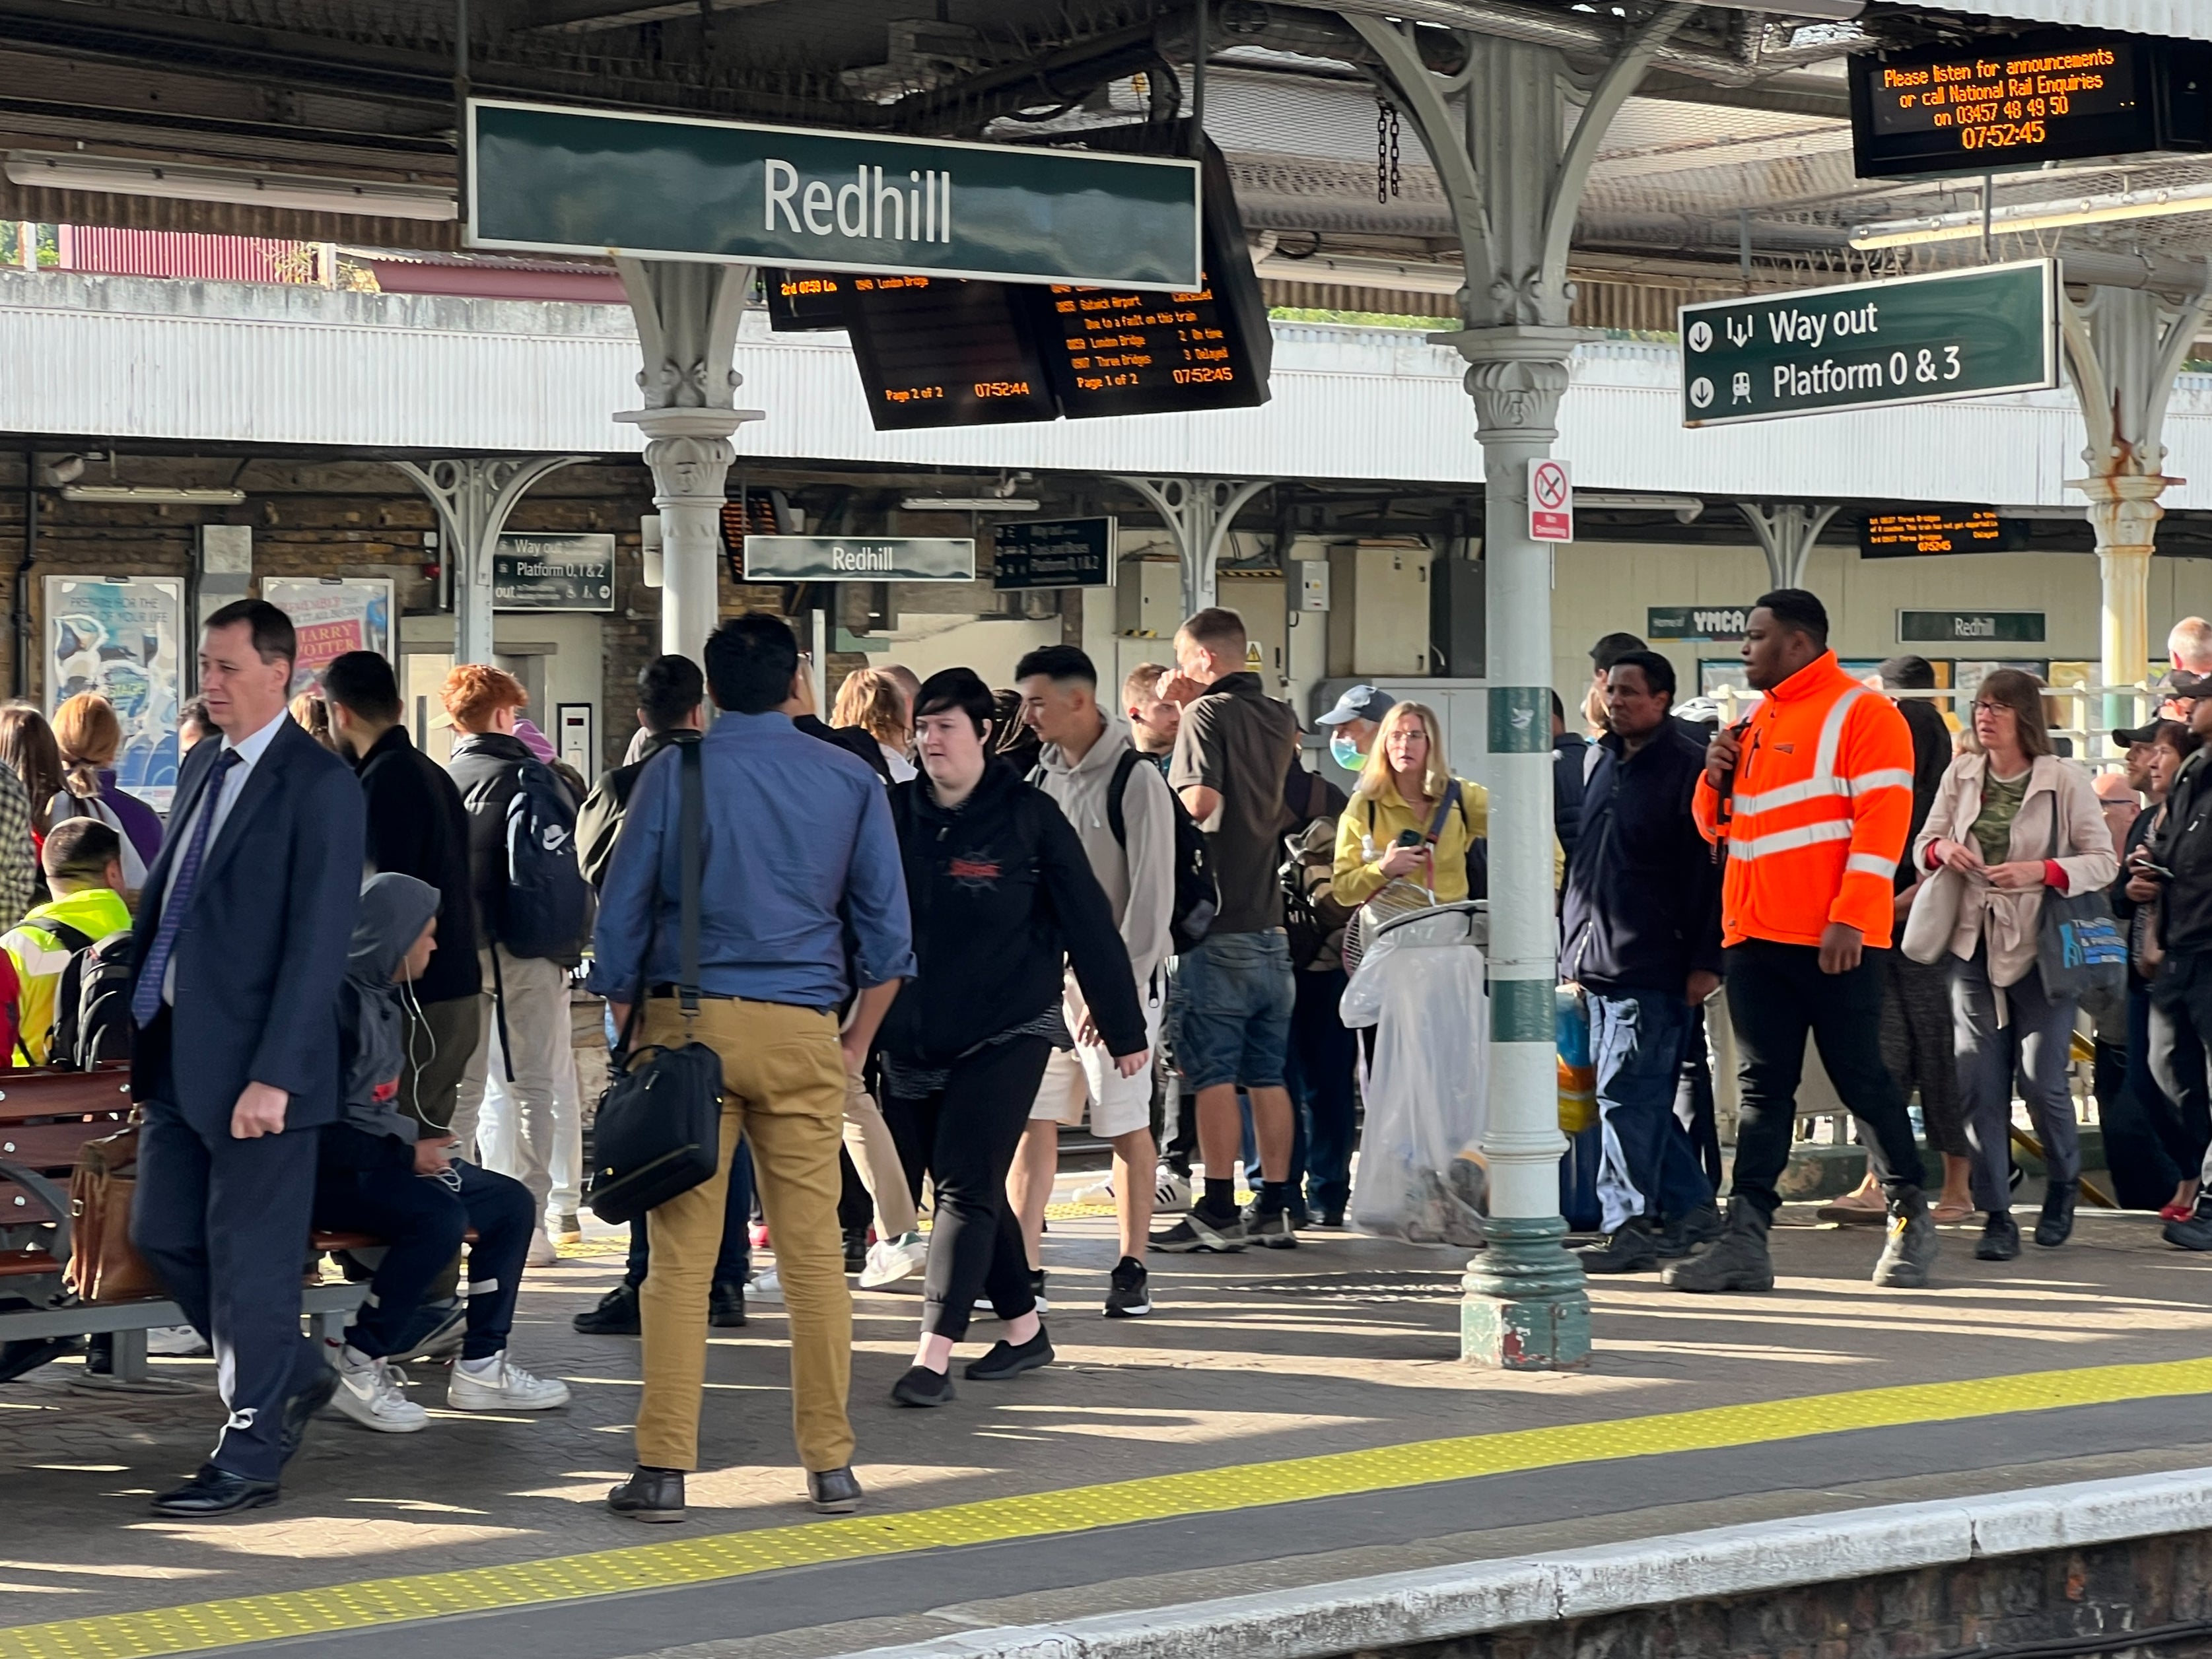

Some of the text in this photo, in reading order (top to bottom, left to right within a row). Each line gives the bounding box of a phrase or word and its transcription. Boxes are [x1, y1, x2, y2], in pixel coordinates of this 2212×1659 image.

[1884, 48, 2114, 88] Please listen for announcements
[1899, 73, 2104, 108] or call National Rail Enquiries
[1933, 96, 2069, 127] on 03457 48 49 50
[1962, 120, 2046, 150] 07:52:45
[763, 159, 951, 244] Redhill
[1102, 318, 1113, 328] to
[1115, 318, 1121, 327] a
[1122, 314, 1144, 327] fault
[1145, 315, 1156, 325] on
[1156, 312, 1173, 324] this
[1175, 310, 1198, 322] train
[1768, 302, 1879, 348] Way out
[1089, 337, 1119, 349] London
[1118, 334, 1146, 349] Bridge
[1094, 356, 1121, 368] Three
[1121, 353, 1153, 368] Bridges
[1076, 367, 1233, 391] Page 1 of 2 07:52:45
[1773, 346, 1960, 399] Platform 0 & 3
[885, 382, 1030, 403] Page 2 of 2 07:52:44
[514, 539, 541, 557] Way
[543, 541, 563, 555] out
[517, 561, 564, 577] Platform
[586, 564, 596, 578] &
[597, 564, 605, 578] 2
[832, 547, 893, 572] Redhill
[139, 597, 160, 609] THE
[495, 585, 516, 599] out
[149, 611, 169, 623] LIFE
[1693, 610, 1745, 633] YMCA
[1954, 617, 1996, 637] Redhill
